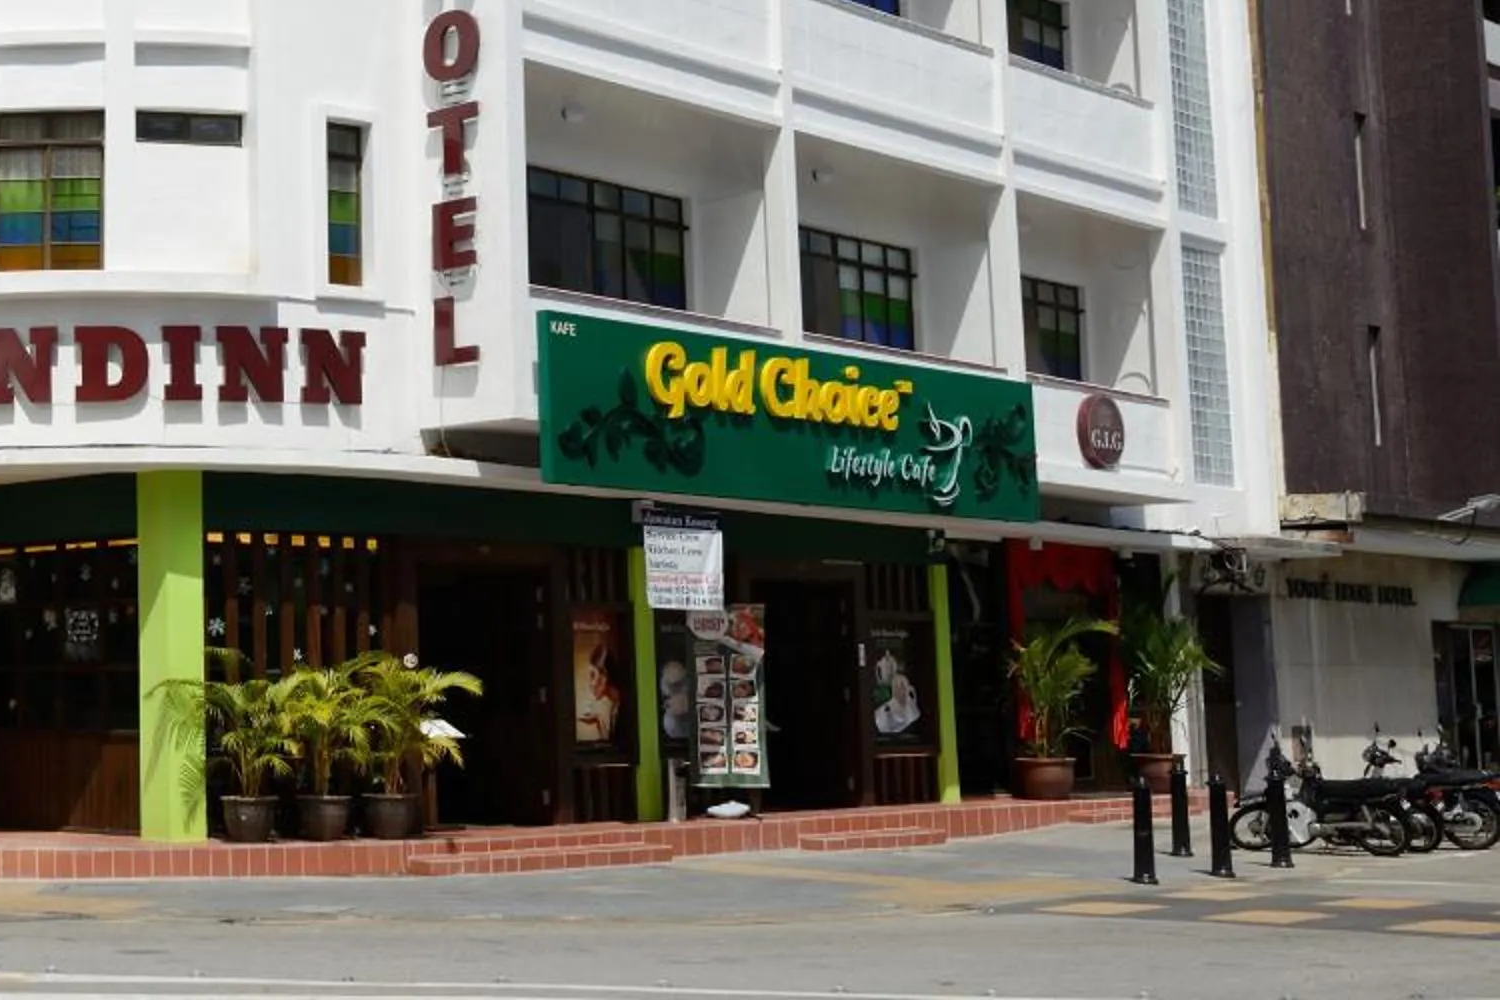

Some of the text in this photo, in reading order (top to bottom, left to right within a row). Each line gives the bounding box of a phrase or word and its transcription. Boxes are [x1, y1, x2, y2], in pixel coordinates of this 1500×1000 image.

[550, 320, 577, 337] KAFE
[645, 341, 901, 432] Gold Choice
[829, 445, 938, 487] Lifestyle Cafe
